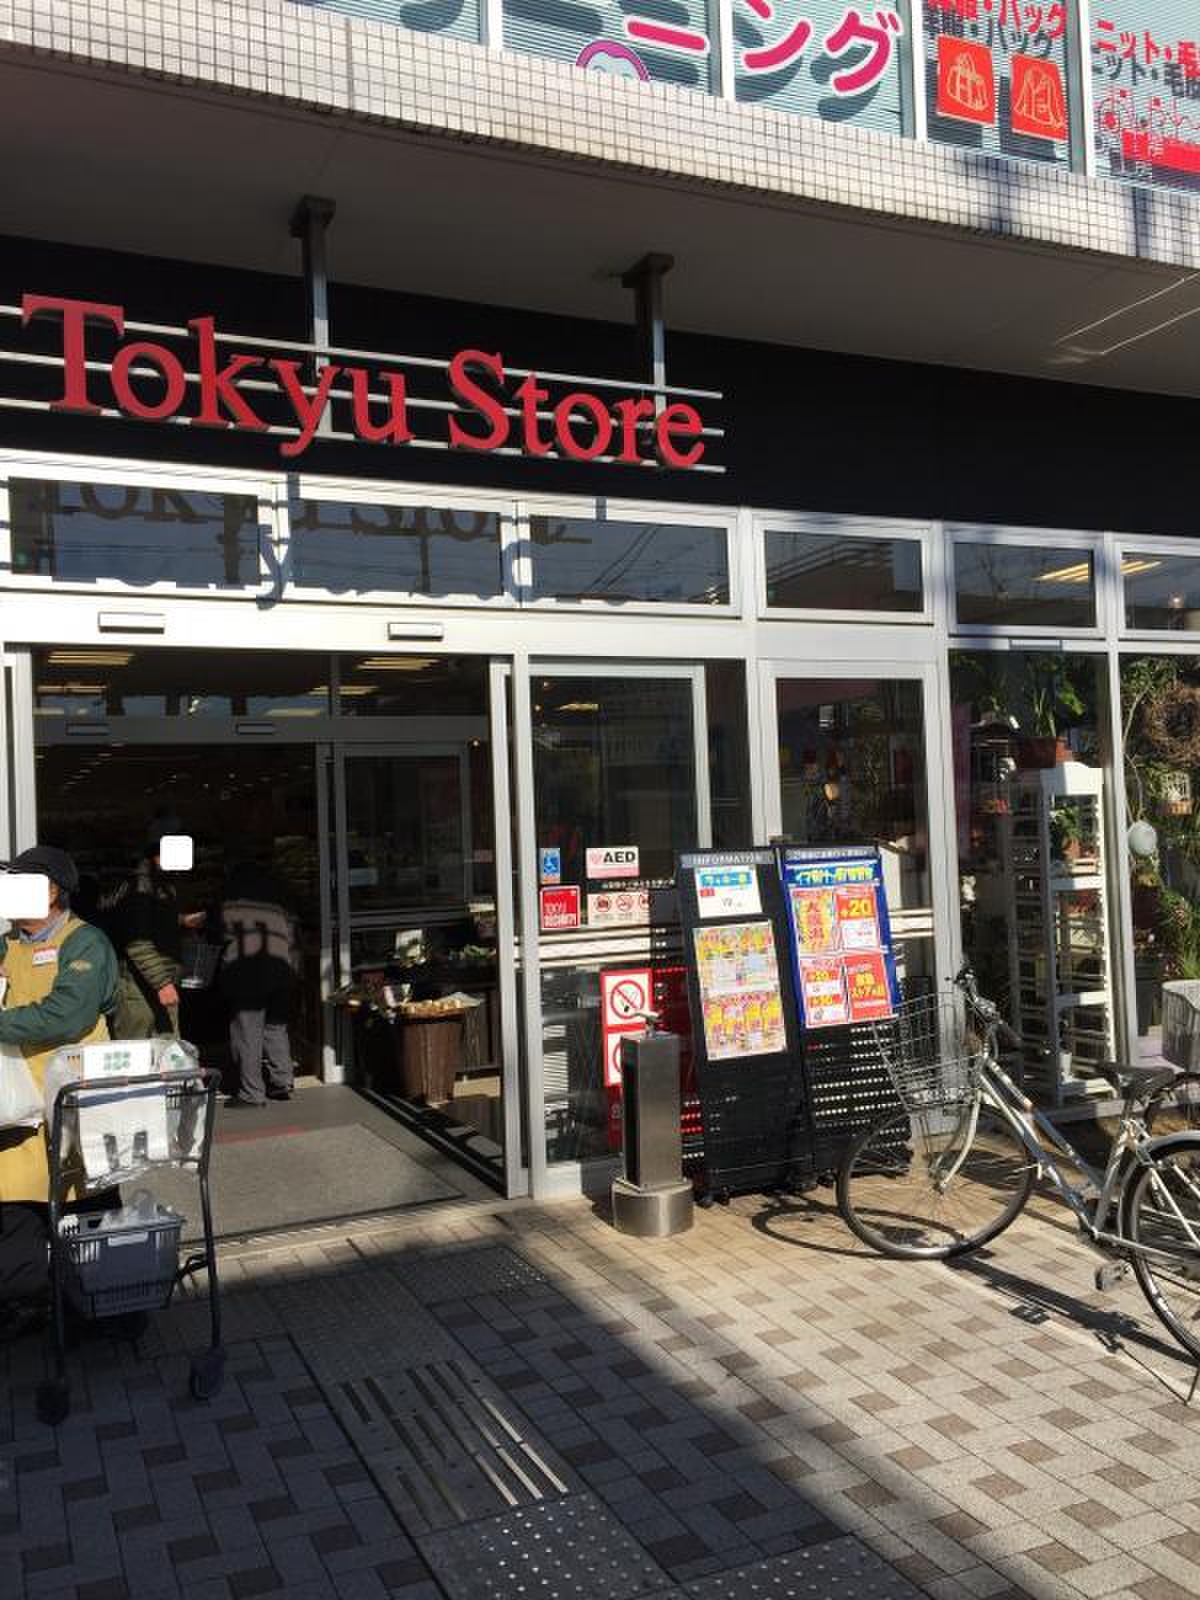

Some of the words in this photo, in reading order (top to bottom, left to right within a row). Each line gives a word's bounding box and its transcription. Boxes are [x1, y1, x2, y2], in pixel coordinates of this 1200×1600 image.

[22, 293, 416, 457] Tokyu
[447, 349, 705, 468] Store
[604, 851, 636, 863] AED
